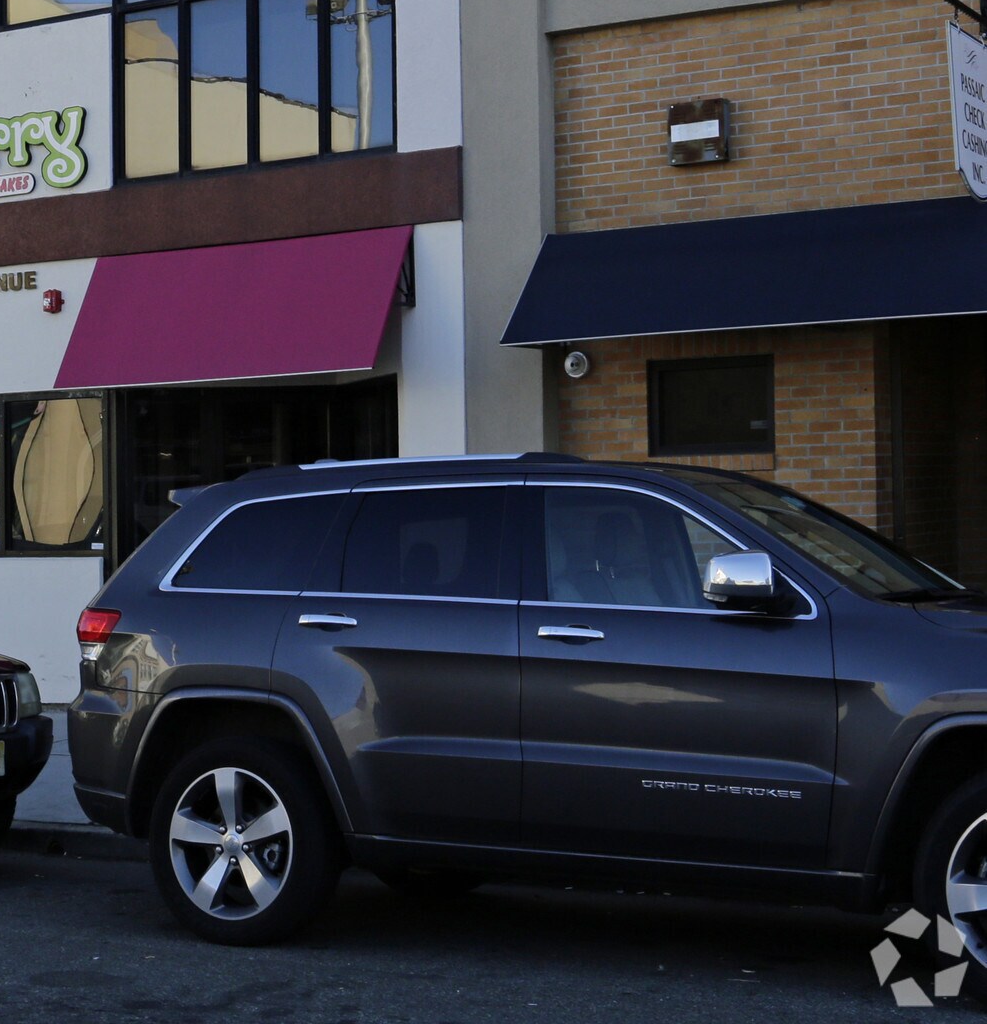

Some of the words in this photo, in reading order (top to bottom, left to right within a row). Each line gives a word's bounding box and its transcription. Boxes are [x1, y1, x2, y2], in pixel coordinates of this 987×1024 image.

[961, 72, 986, 103] PASSAIC
[964, 102, 987, 130] CHECK
[641, 779, 700, 791] GRAND
[704, 783, 802, 799] CHEROKEE
